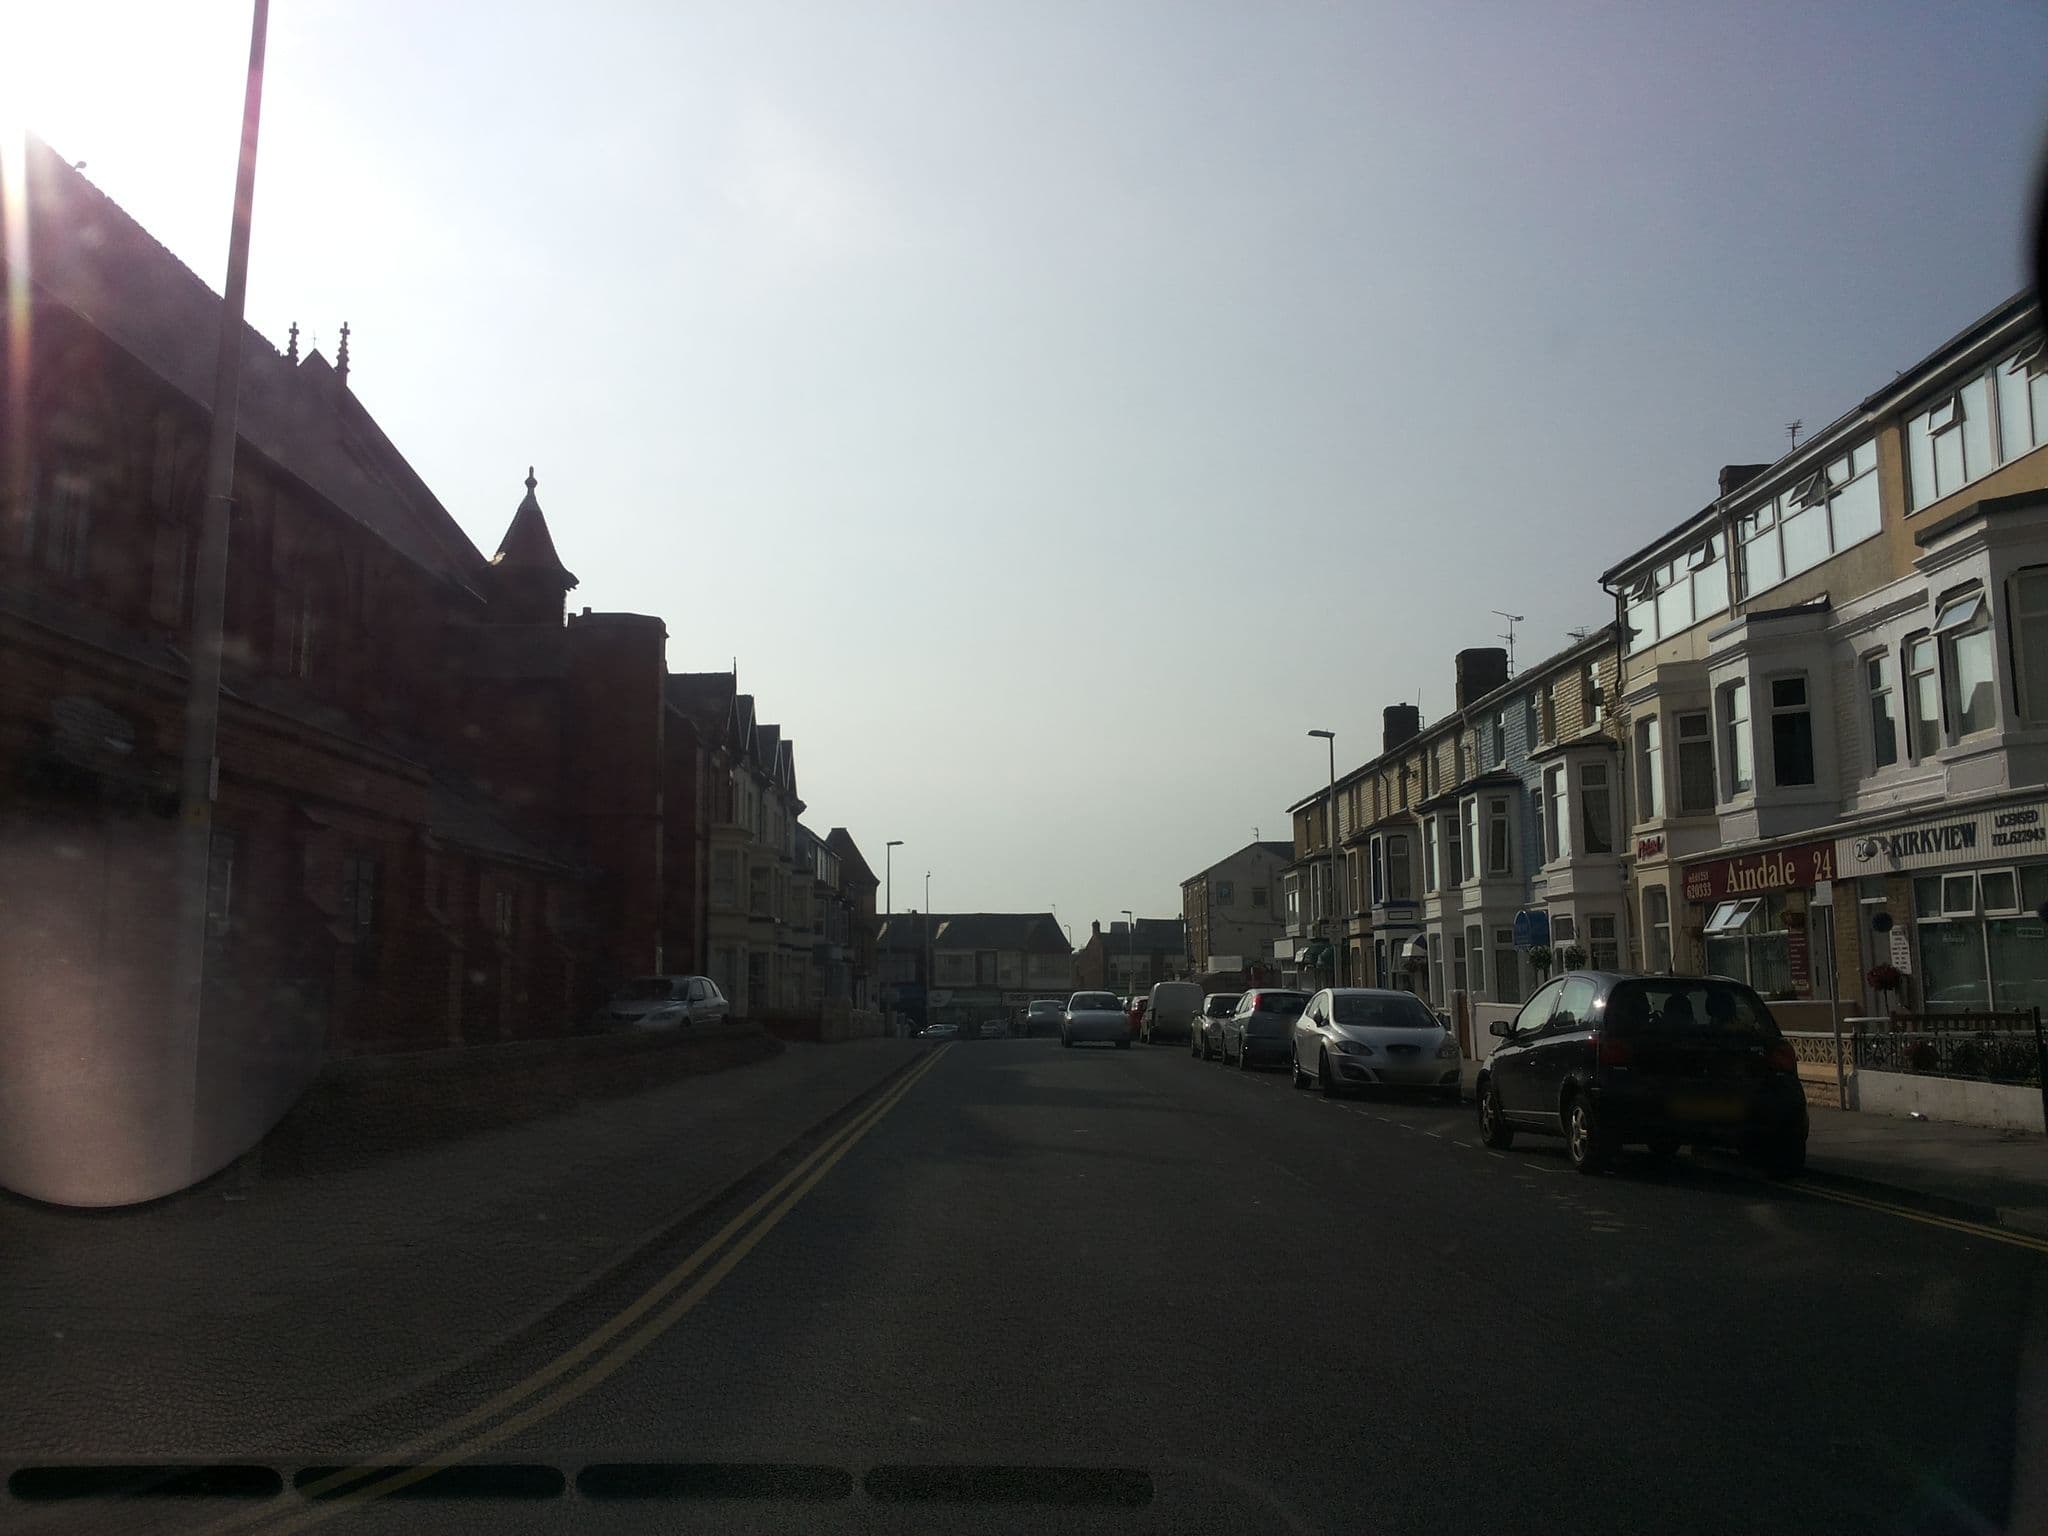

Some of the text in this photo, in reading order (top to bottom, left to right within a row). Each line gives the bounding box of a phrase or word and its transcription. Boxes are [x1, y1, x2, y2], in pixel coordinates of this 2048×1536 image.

[1891, 822, 1976, 858] KIRKVIEW
[1726, 849, 1832, 893] Aindale 24
